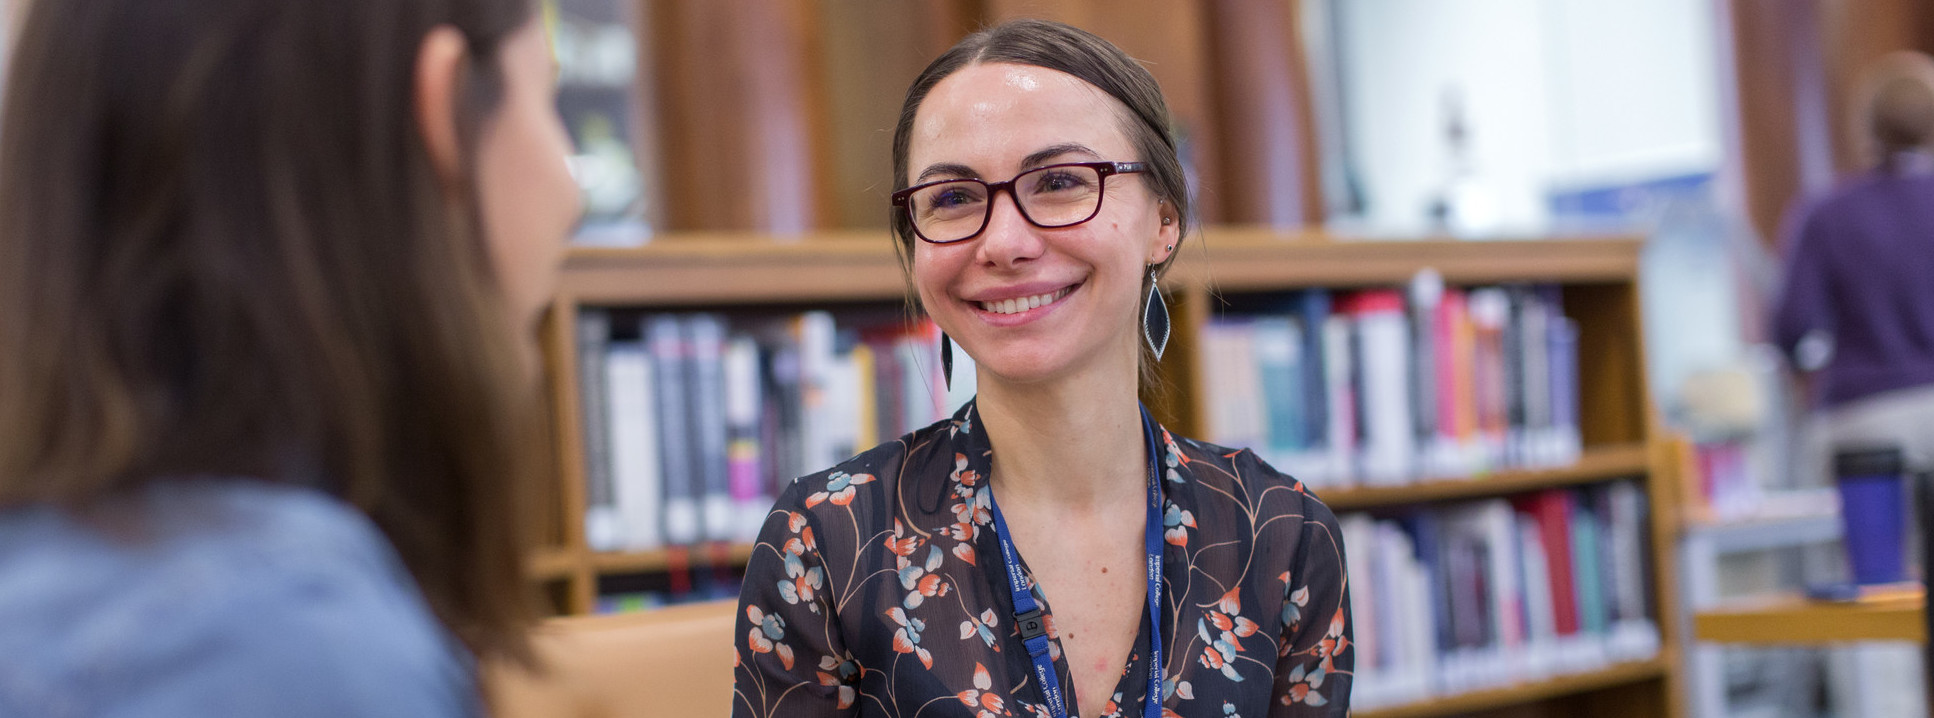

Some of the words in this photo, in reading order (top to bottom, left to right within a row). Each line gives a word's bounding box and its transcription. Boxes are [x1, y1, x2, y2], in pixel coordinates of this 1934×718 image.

[1009, 564, 1020, 592] Imperial
[1015, 564, 1027, 591] London
[1037, 664, 1048, 690] College
[1152, 679, 1160, 705] College
